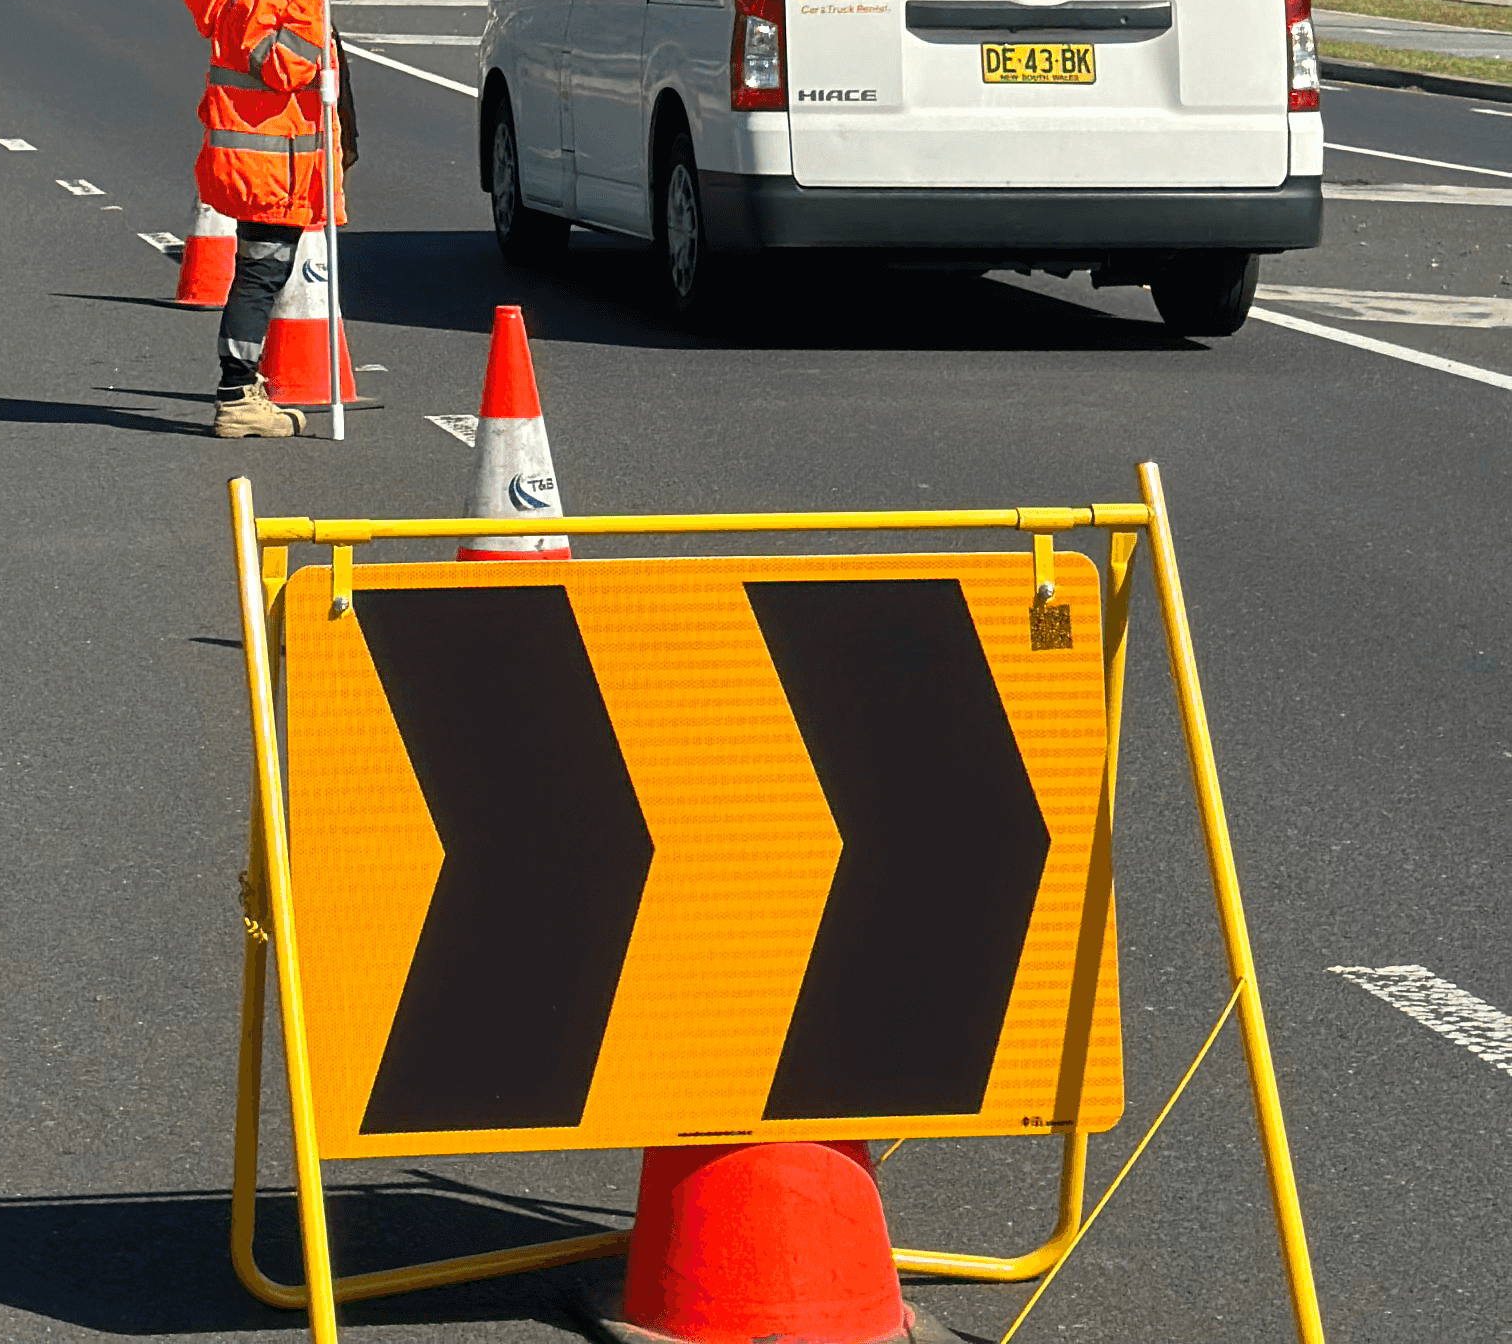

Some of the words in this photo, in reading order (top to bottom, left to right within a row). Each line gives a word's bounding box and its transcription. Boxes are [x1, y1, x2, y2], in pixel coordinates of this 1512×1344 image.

[800, 4, 818, 14] Car
[826, 4, 855, 14] Truck
[798, 89, 877, 102] HIACE
[527, 477, 554, 492] T&B
